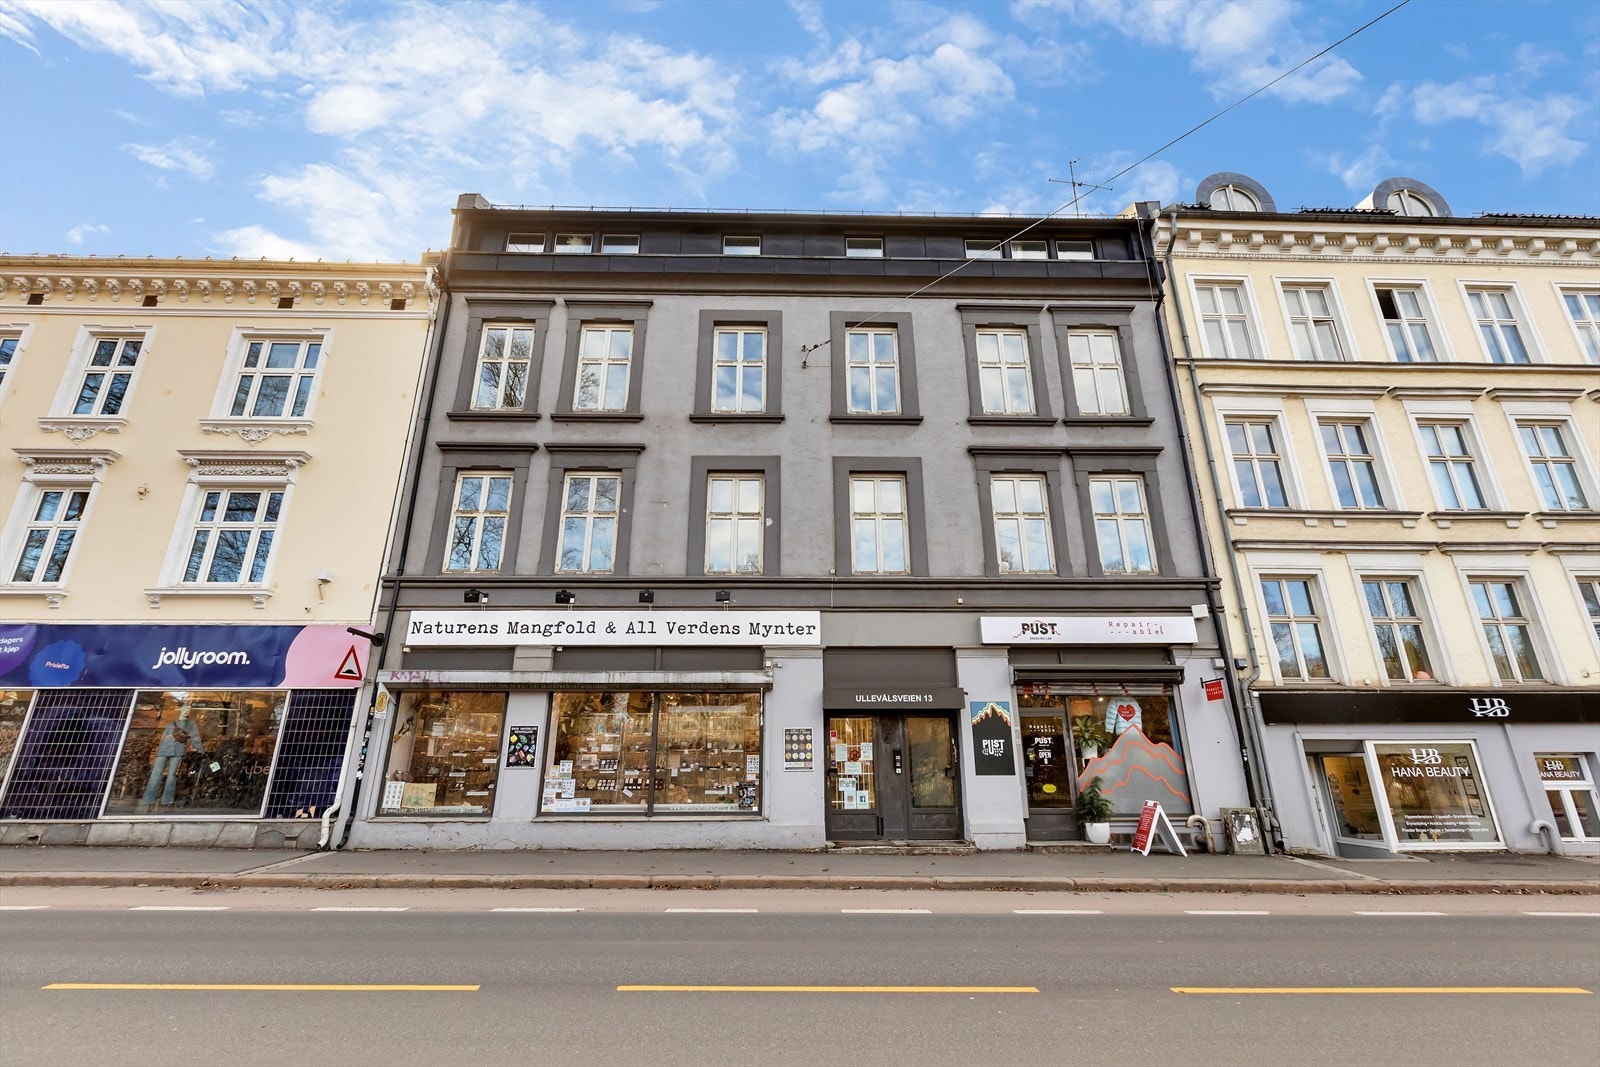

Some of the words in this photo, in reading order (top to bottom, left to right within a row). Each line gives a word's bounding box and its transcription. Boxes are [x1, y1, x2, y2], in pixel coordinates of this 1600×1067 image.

[411, 621, 499, 634] Naturens
[507, 621, 596, 637] Mangfold
[605, 621, 617, 634] &
[625, 621, 657, 634] All
[666, 621, 741, 635] Verdens
[749, 622, 816, 638] Mynter
[1021, 622, 1058, 635] PUST
[0, 637, 24, 645] dagers
[152, 647, 251, 670] jollyroom.
[855, 694, 922, 703] ULLEVÅLSVEIEN
[923, 694, 933, 702] 13
[1468, 697, 1511, 717] HB
[982, 739, 1005, 755] PUST
[1408, 748, 1443, 765] HB
[1391, 766, 1425, 777] HANA
[1425, 766, 1469, 777] BEAUTY
